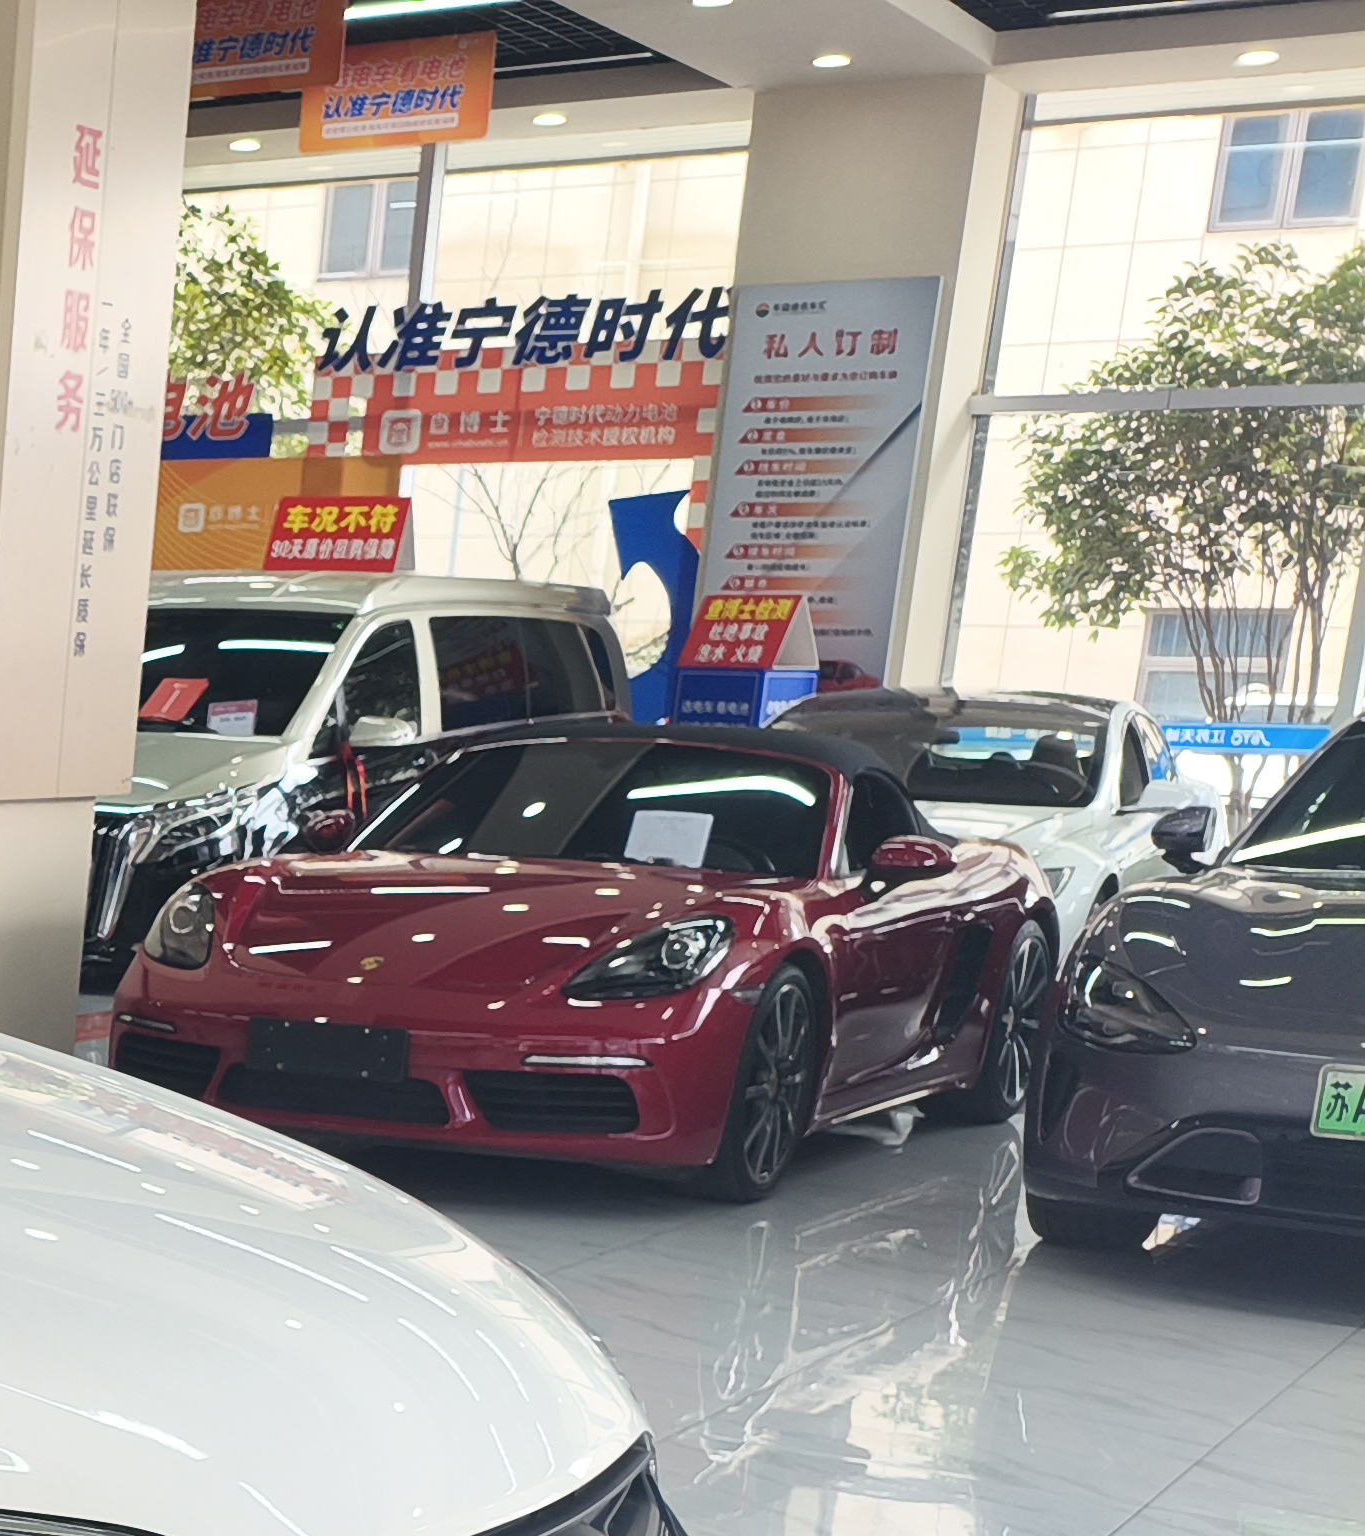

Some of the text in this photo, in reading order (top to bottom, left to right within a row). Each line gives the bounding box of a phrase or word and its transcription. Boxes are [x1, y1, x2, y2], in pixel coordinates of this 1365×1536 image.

[54, 124, 104, 434] 延保服务
[317, 287, 732, 373] 认准宁德时代
[763, 328, 899, 360] 私人订制
[282, 504, 400, 534] 车况不符
